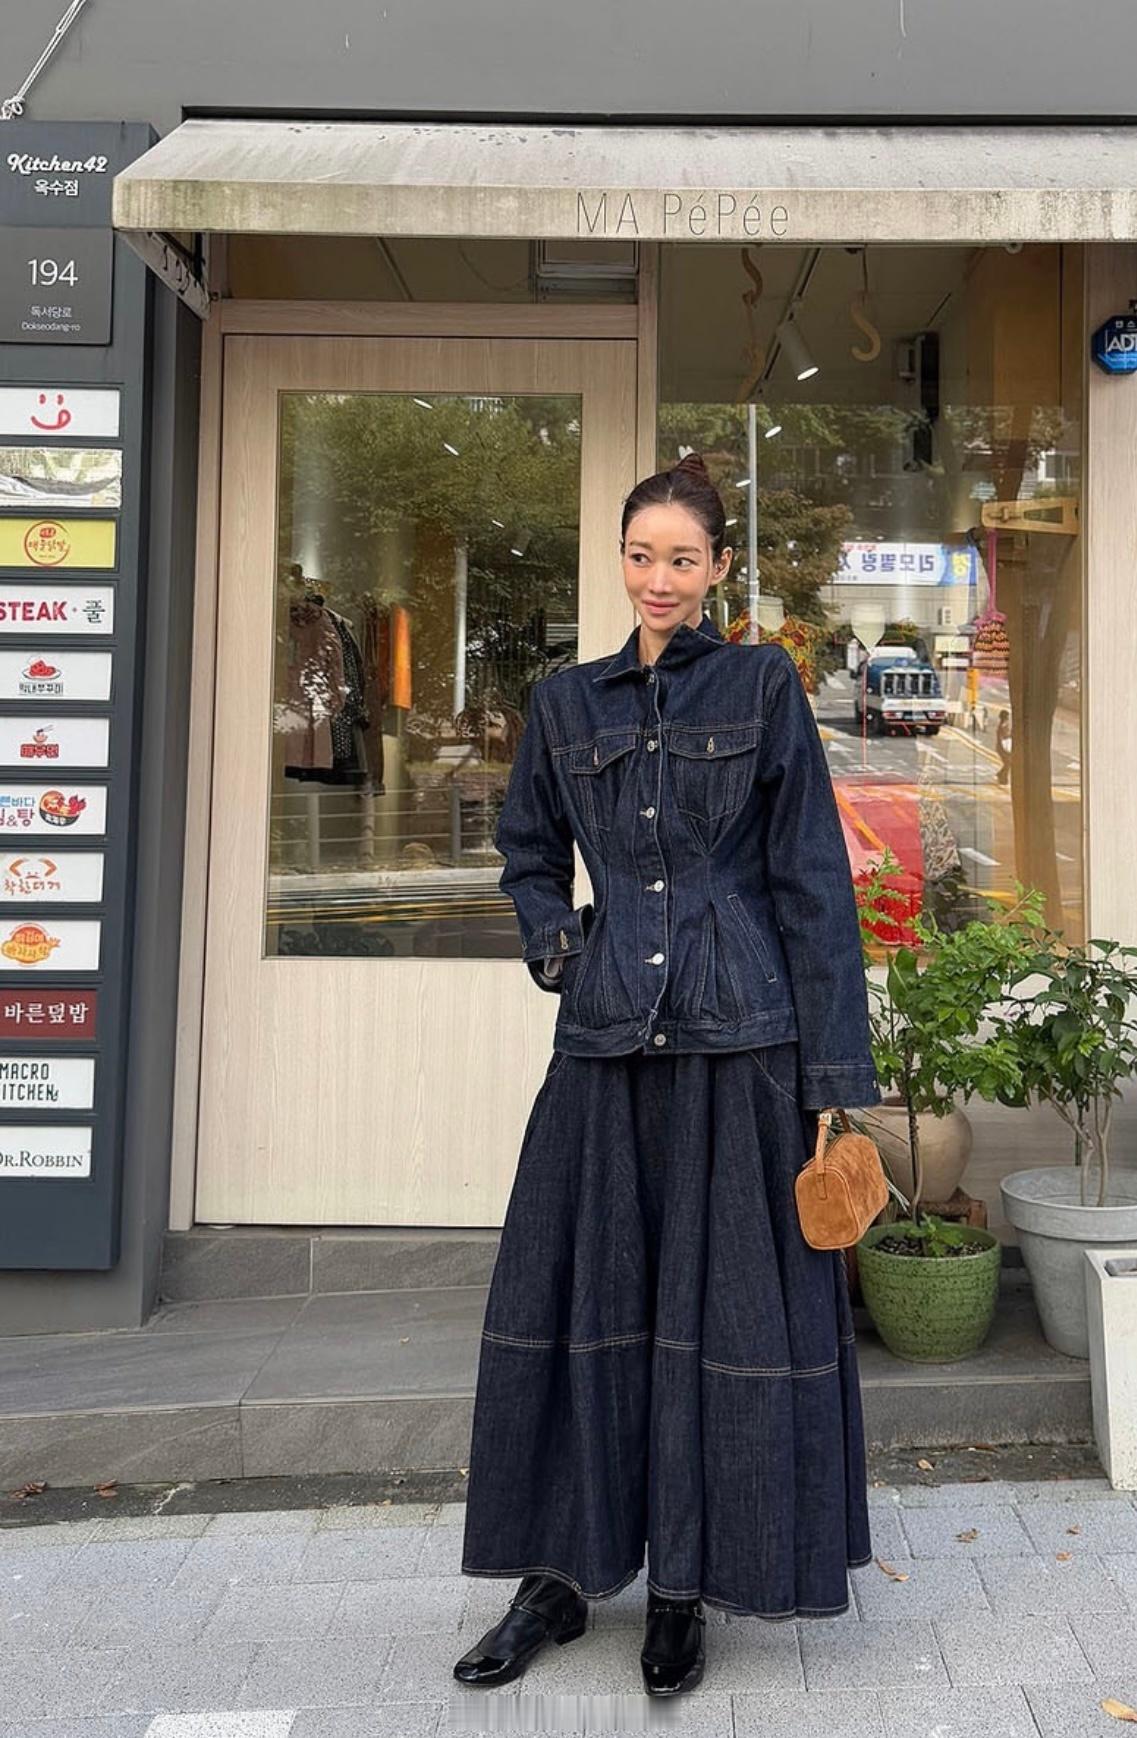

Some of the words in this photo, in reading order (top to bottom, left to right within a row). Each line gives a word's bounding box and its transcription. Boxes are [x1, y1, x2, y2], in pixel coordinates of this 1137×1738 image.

[7, 153, 108, 175] Kitchen42
[34, 180, 79, 197] 옥수점
[577, 192, 639, 235] MA
[663, 192, 789, 236] PéPée
[28, 259, 79, 287] 194
[4, 1002, 89, 1025] 바른덮밥
[0, 1062, 49, 1080] MACRO
[1, 1083, 57, 1101] ITCHEN
